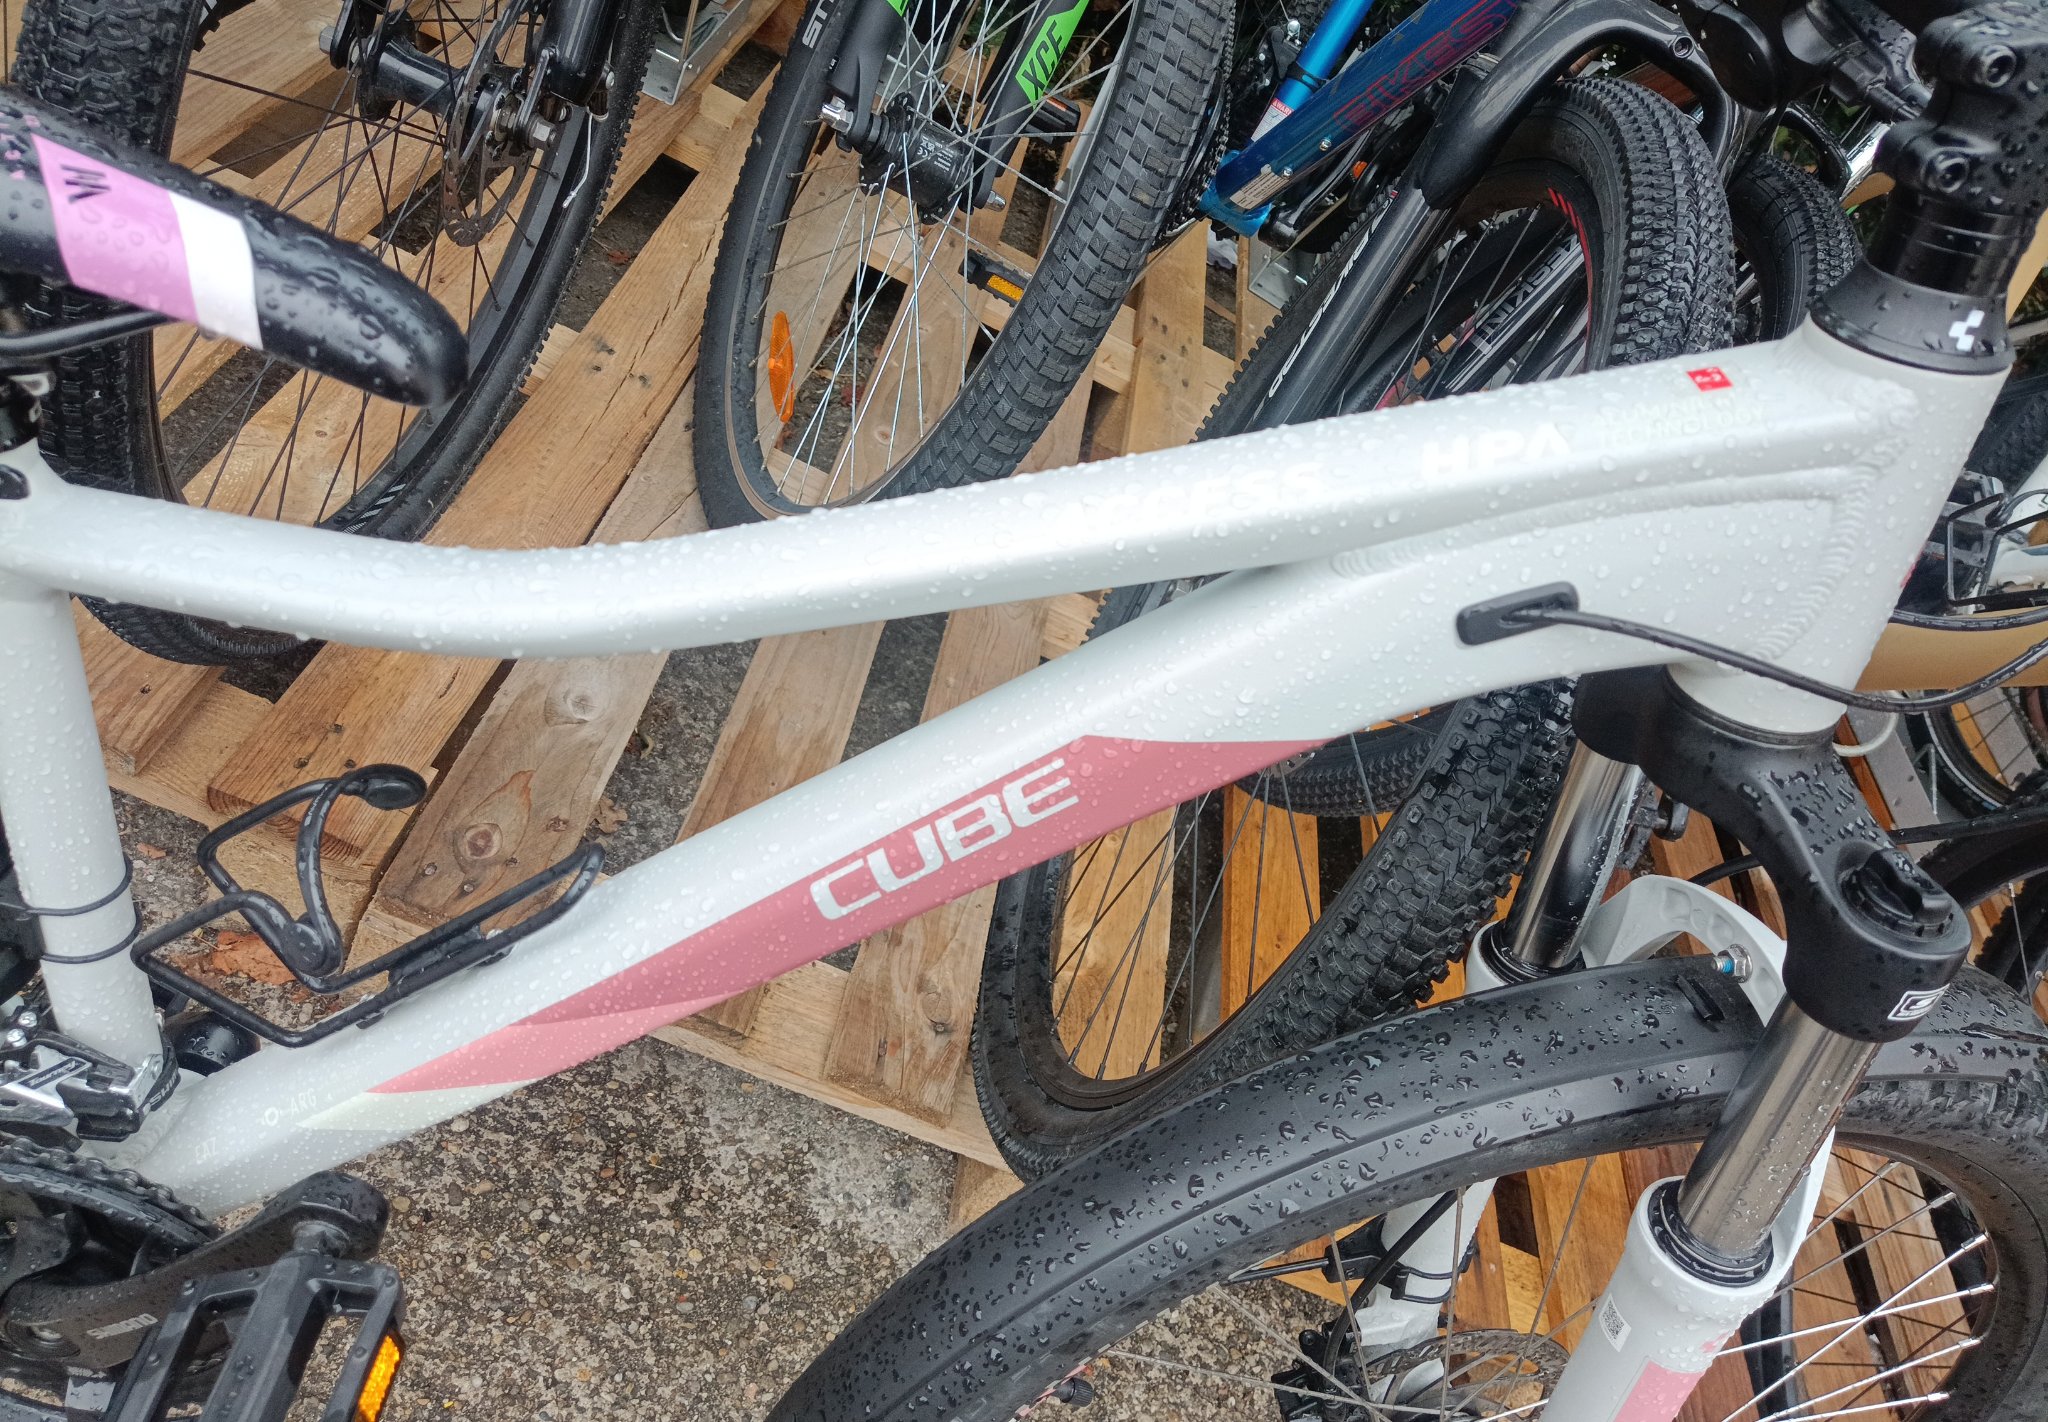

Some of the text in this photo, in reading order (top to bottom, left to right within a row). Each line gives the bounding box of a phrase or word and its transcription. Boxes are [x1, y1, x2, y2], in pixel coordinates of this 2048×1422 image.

[802, 0, 835, 49] ST
[1021, 19, 1063, 101] XCE
[810, 758, 1079, 920] CUBE
